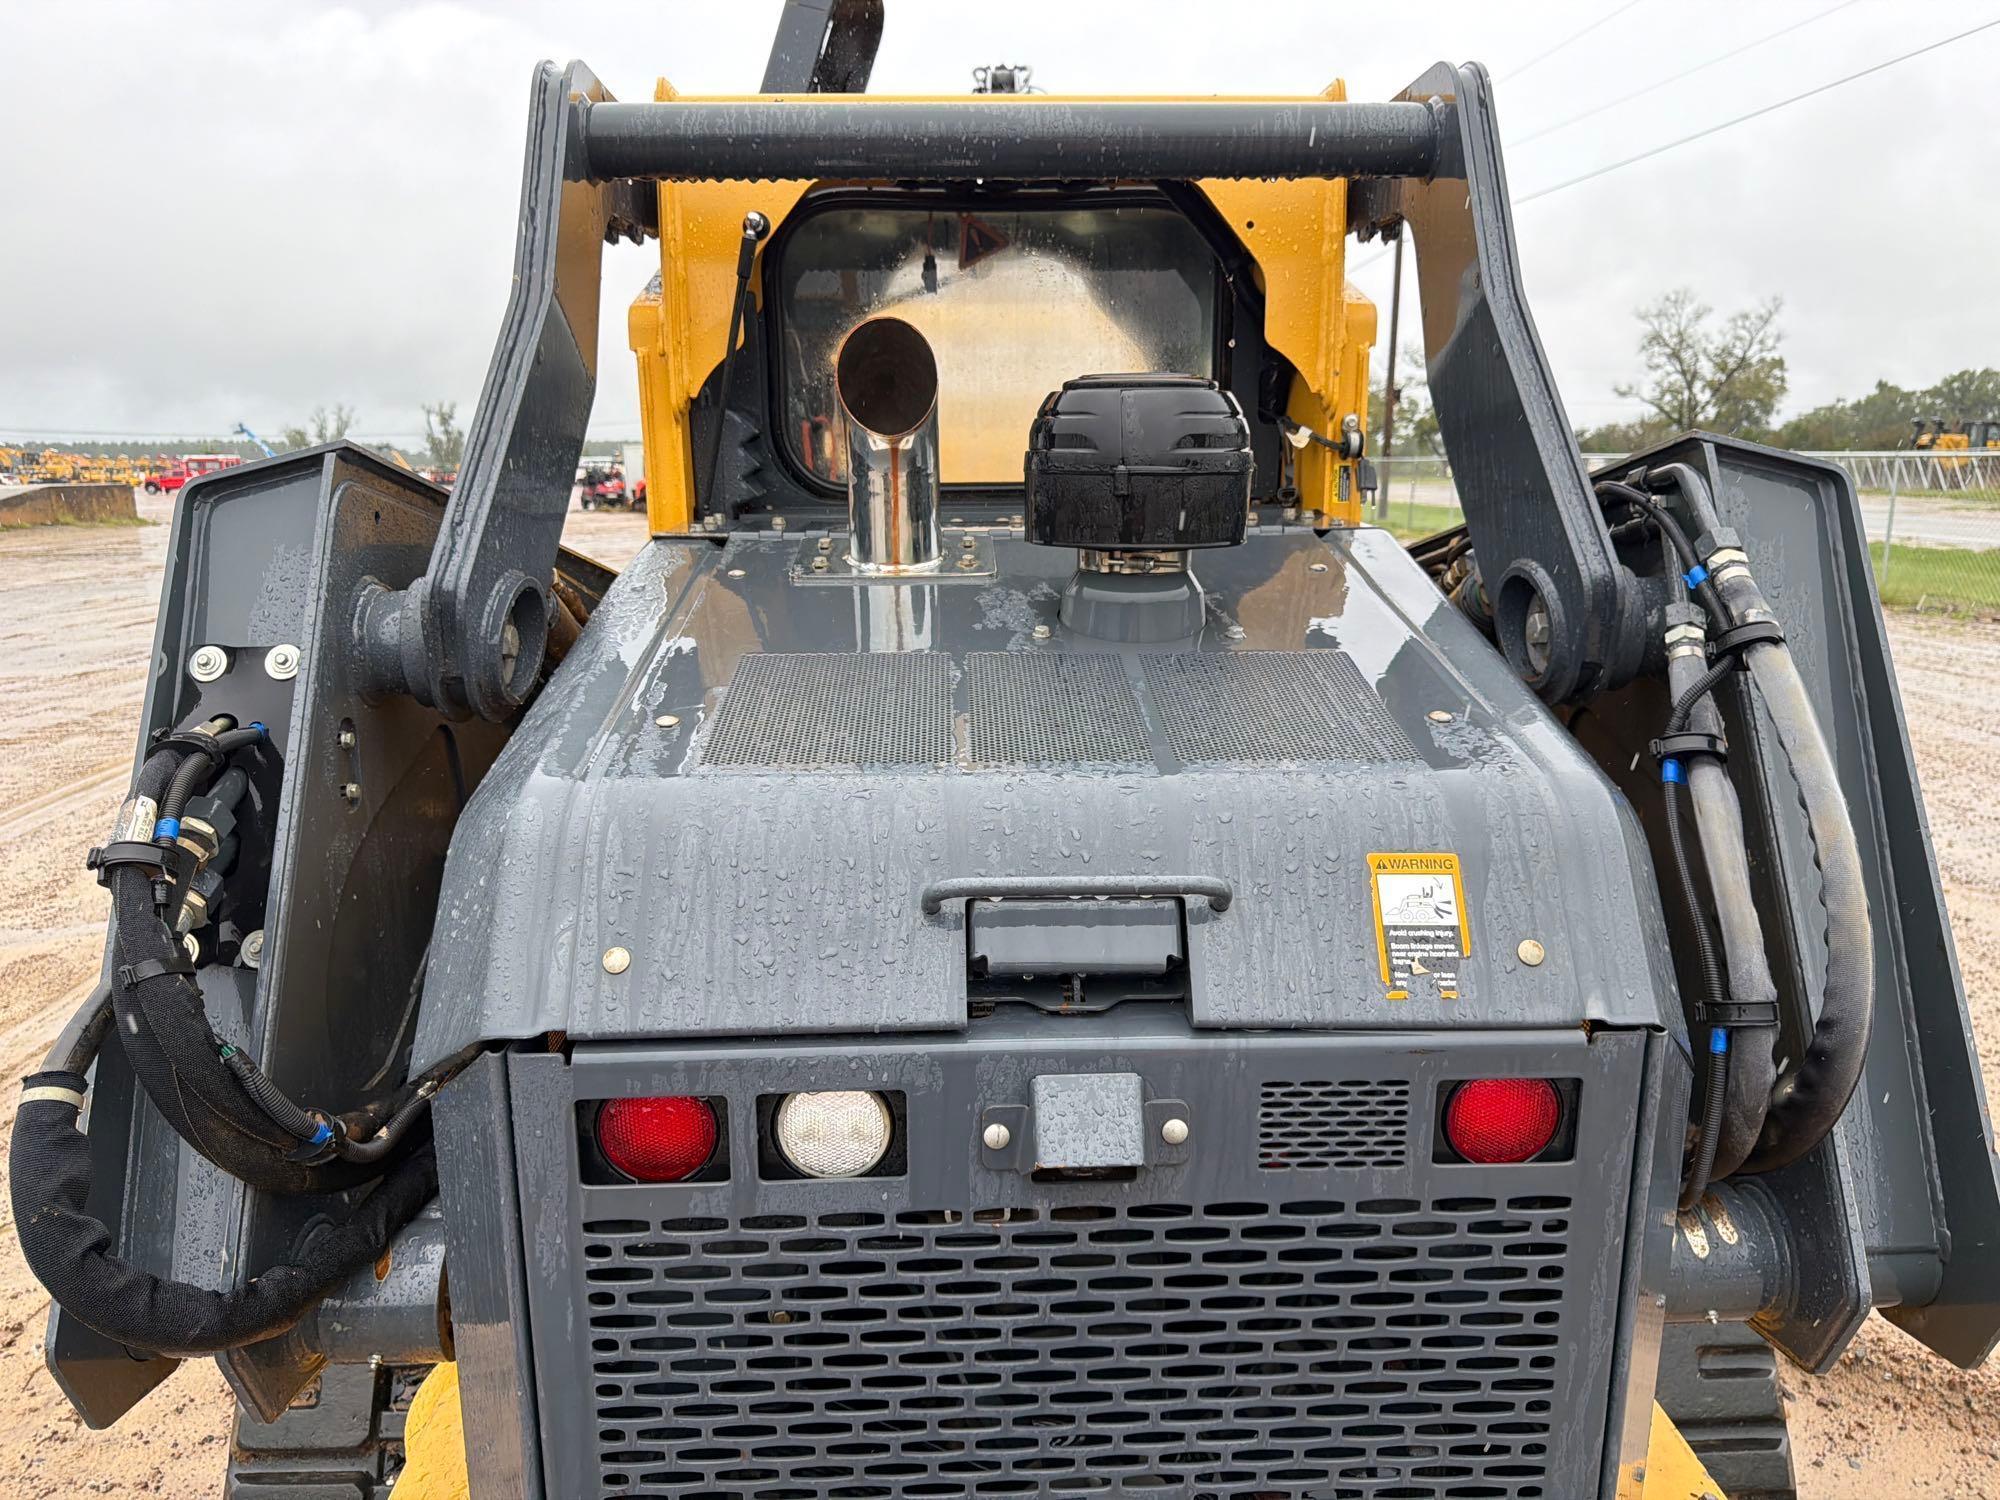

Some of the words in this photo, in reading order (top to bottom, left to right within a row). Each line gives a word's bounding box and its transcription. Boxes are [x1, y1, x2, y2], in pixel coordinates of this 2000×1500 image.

[1388, 859, 1454, 870] WARNING
[1389, 929, 1407, 937] Avoid
[1408, 930, 1435, 938] crushing
[1390, 942, 1410, 950] Boom
[1410, 943, 1433, 951] linkage
